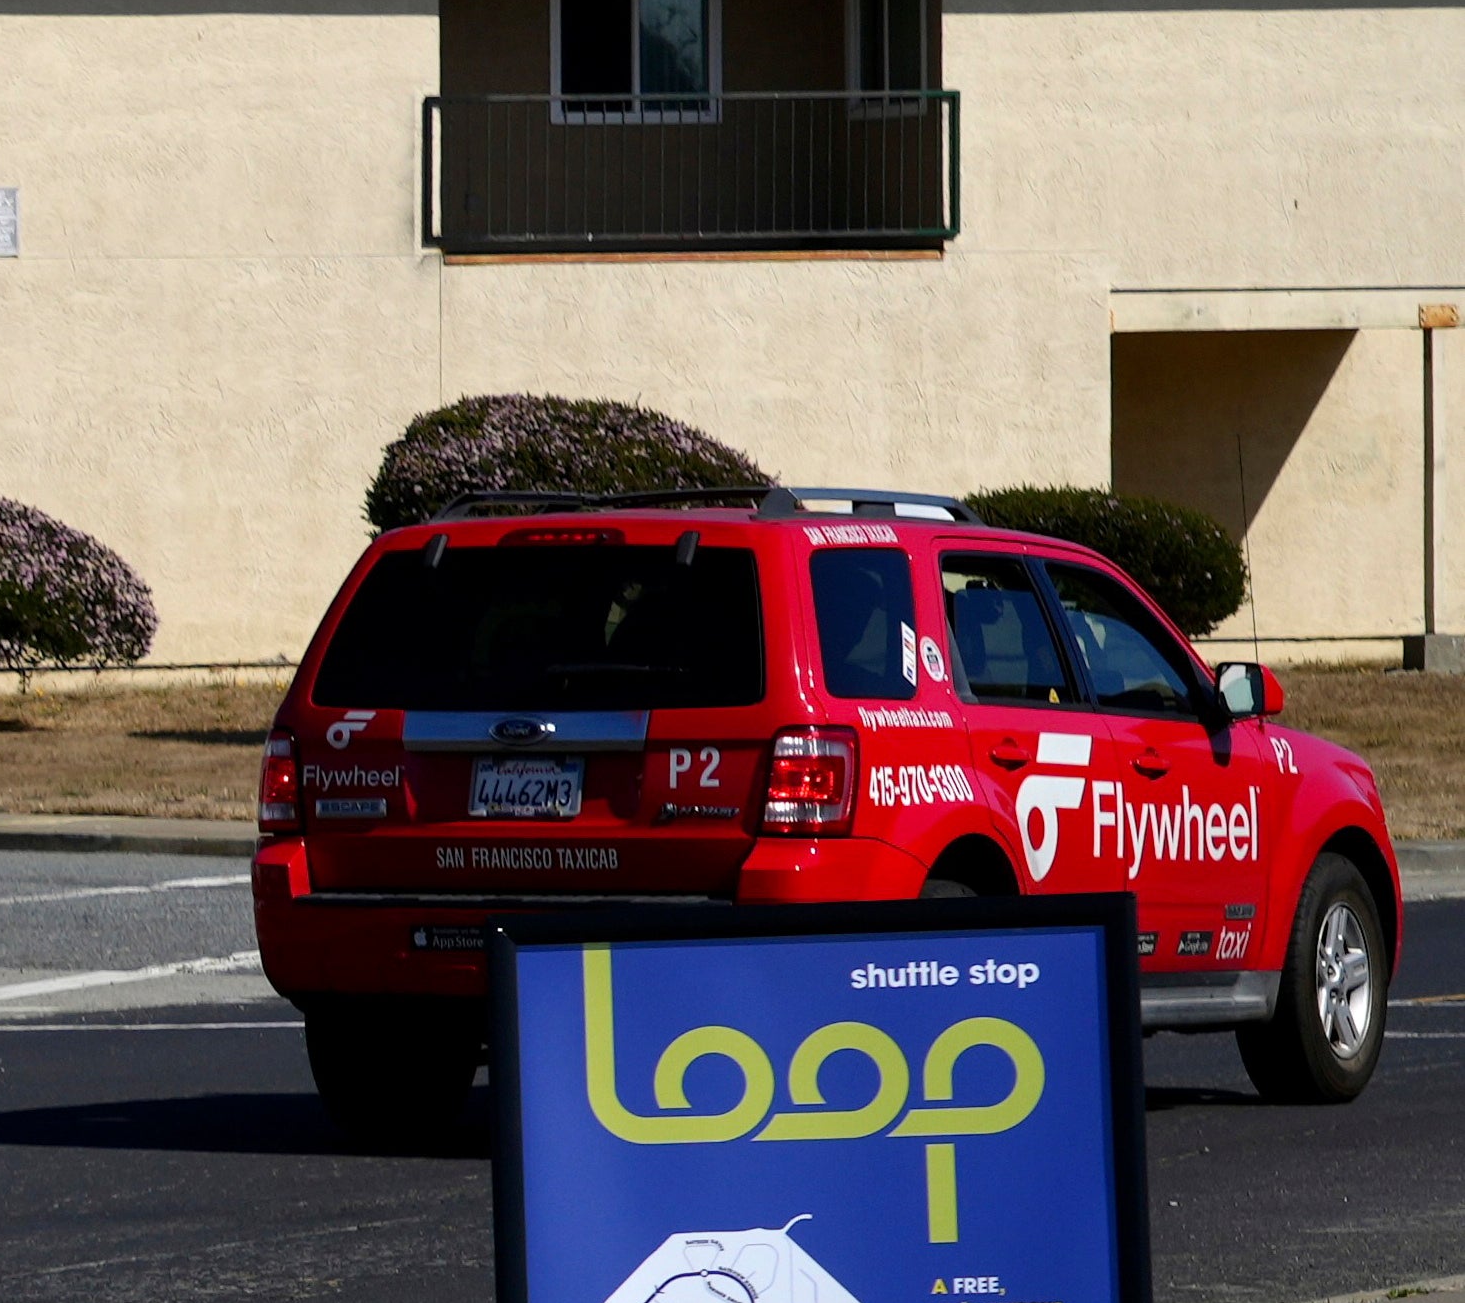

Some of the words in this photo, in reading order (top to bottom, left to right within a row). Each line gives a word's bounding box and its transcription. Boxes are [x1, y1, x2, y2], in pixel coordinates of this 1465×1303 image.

[858, 704, 954, 733] flywheeltaxi.com
[1270, 737, 1300, 775] P2
[303, 764, 400, 793] Flywheel
[477, 777, 573, 808] 44462M3
[868, 763, 975, 807] 415-970-1300
[1091, 779, 1260, 881] Flywheel
[436, 846, 465, 869] SAN
[471, 846, 553, 871] FRANCISCO
[557, 846, 619, 870] TAXICAB
[432, 935, 454, 950] App
[456, 935, 484, 948] Store
[1216, 922, 1252, 961] taxi
[850, 960, 959, 990] shuttle
[969, 959, 1041, 989] stop
[583, 942, 1046, 1244] loop
[931, 1278, 948, 1295] A
[953, 1276, 1006, 1296] FREE,
